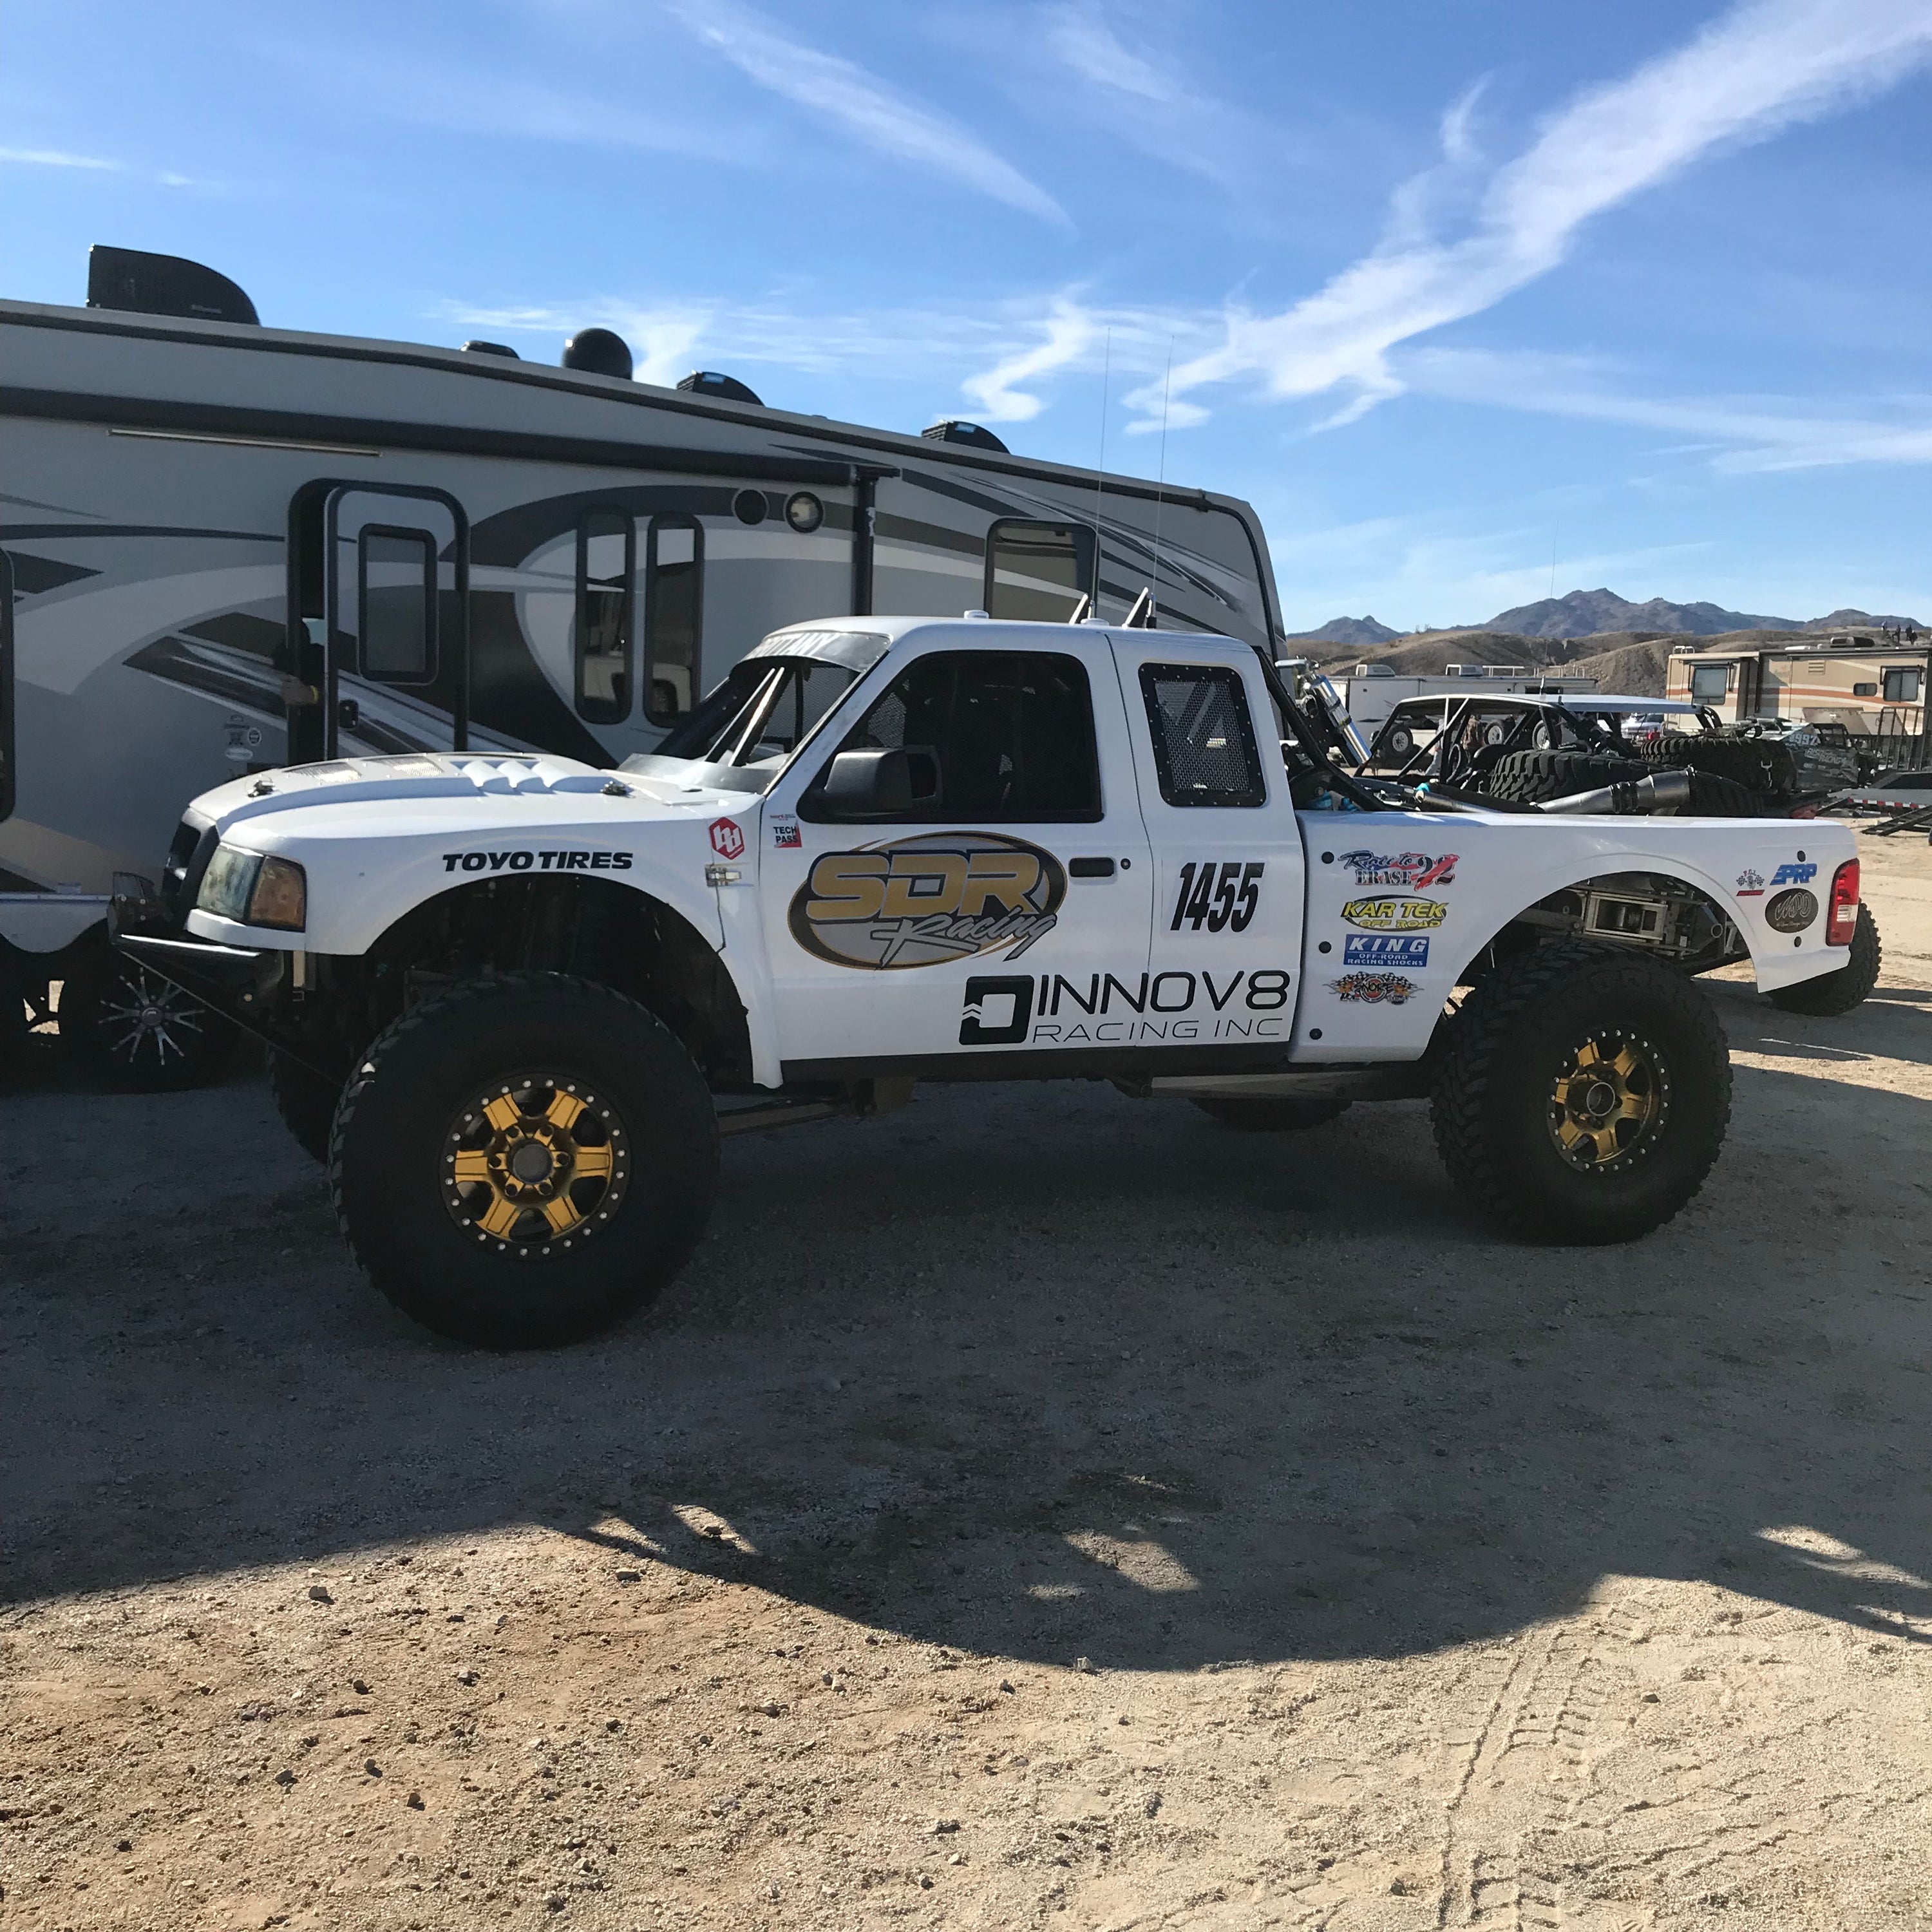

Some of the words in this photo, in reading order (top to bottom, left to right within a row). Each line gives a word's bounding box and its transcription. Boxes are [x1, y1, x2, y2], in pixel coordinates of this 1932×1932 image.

[442, 851, 535, 871] TOYO
[538, 851, 633, 869] TIRES
[806, 850, 1045, 922] SDR
[1356, 869, 1412, 886] ERASE
[1170, 862, 1265, 933] 1455
[1341, 902, 1396, 918] KAR
[1401, 902, 1448, 918] TEK
[1359, 919, 1392, 928] OFF
[1396, 920, 1442, 929] ROAD
[870, 904, 1057, 971] Racing
[1349, 937, 1427, 952] KING
[1037, 970, 1290, 1016] INNOV8
[1033, 1019, 1199, 1043] RACING
[1215, 1018, 1283, 1037] INC
